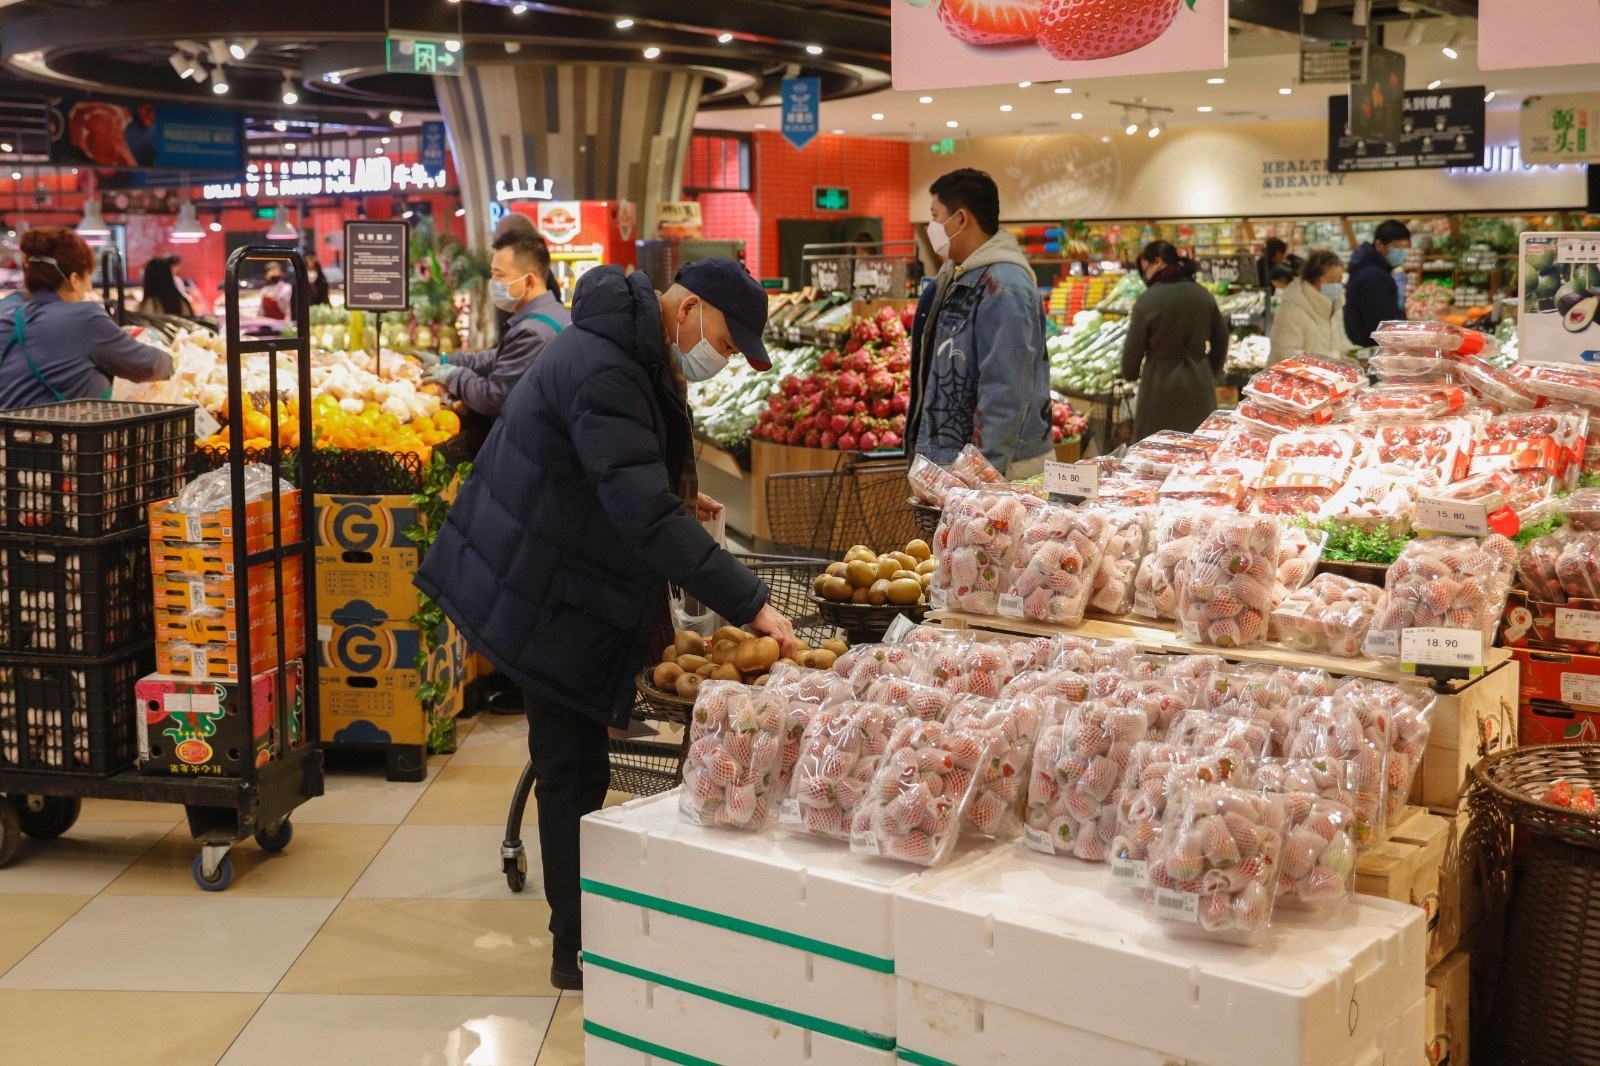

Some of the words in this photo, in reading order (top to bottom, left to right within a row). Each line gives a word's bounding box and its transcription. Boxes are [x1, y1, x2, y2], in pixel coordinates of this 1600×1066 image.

[1262, 173, 1346, 189] &BEAUTY
[1058, 473, 1080, 482] 16.80
[1436, 510, 1465, 520] 15.80
[333, 503, 379, 551] G
[337, 626, 382, 673] G
[1426, 638, 1458, 648] 18.90
